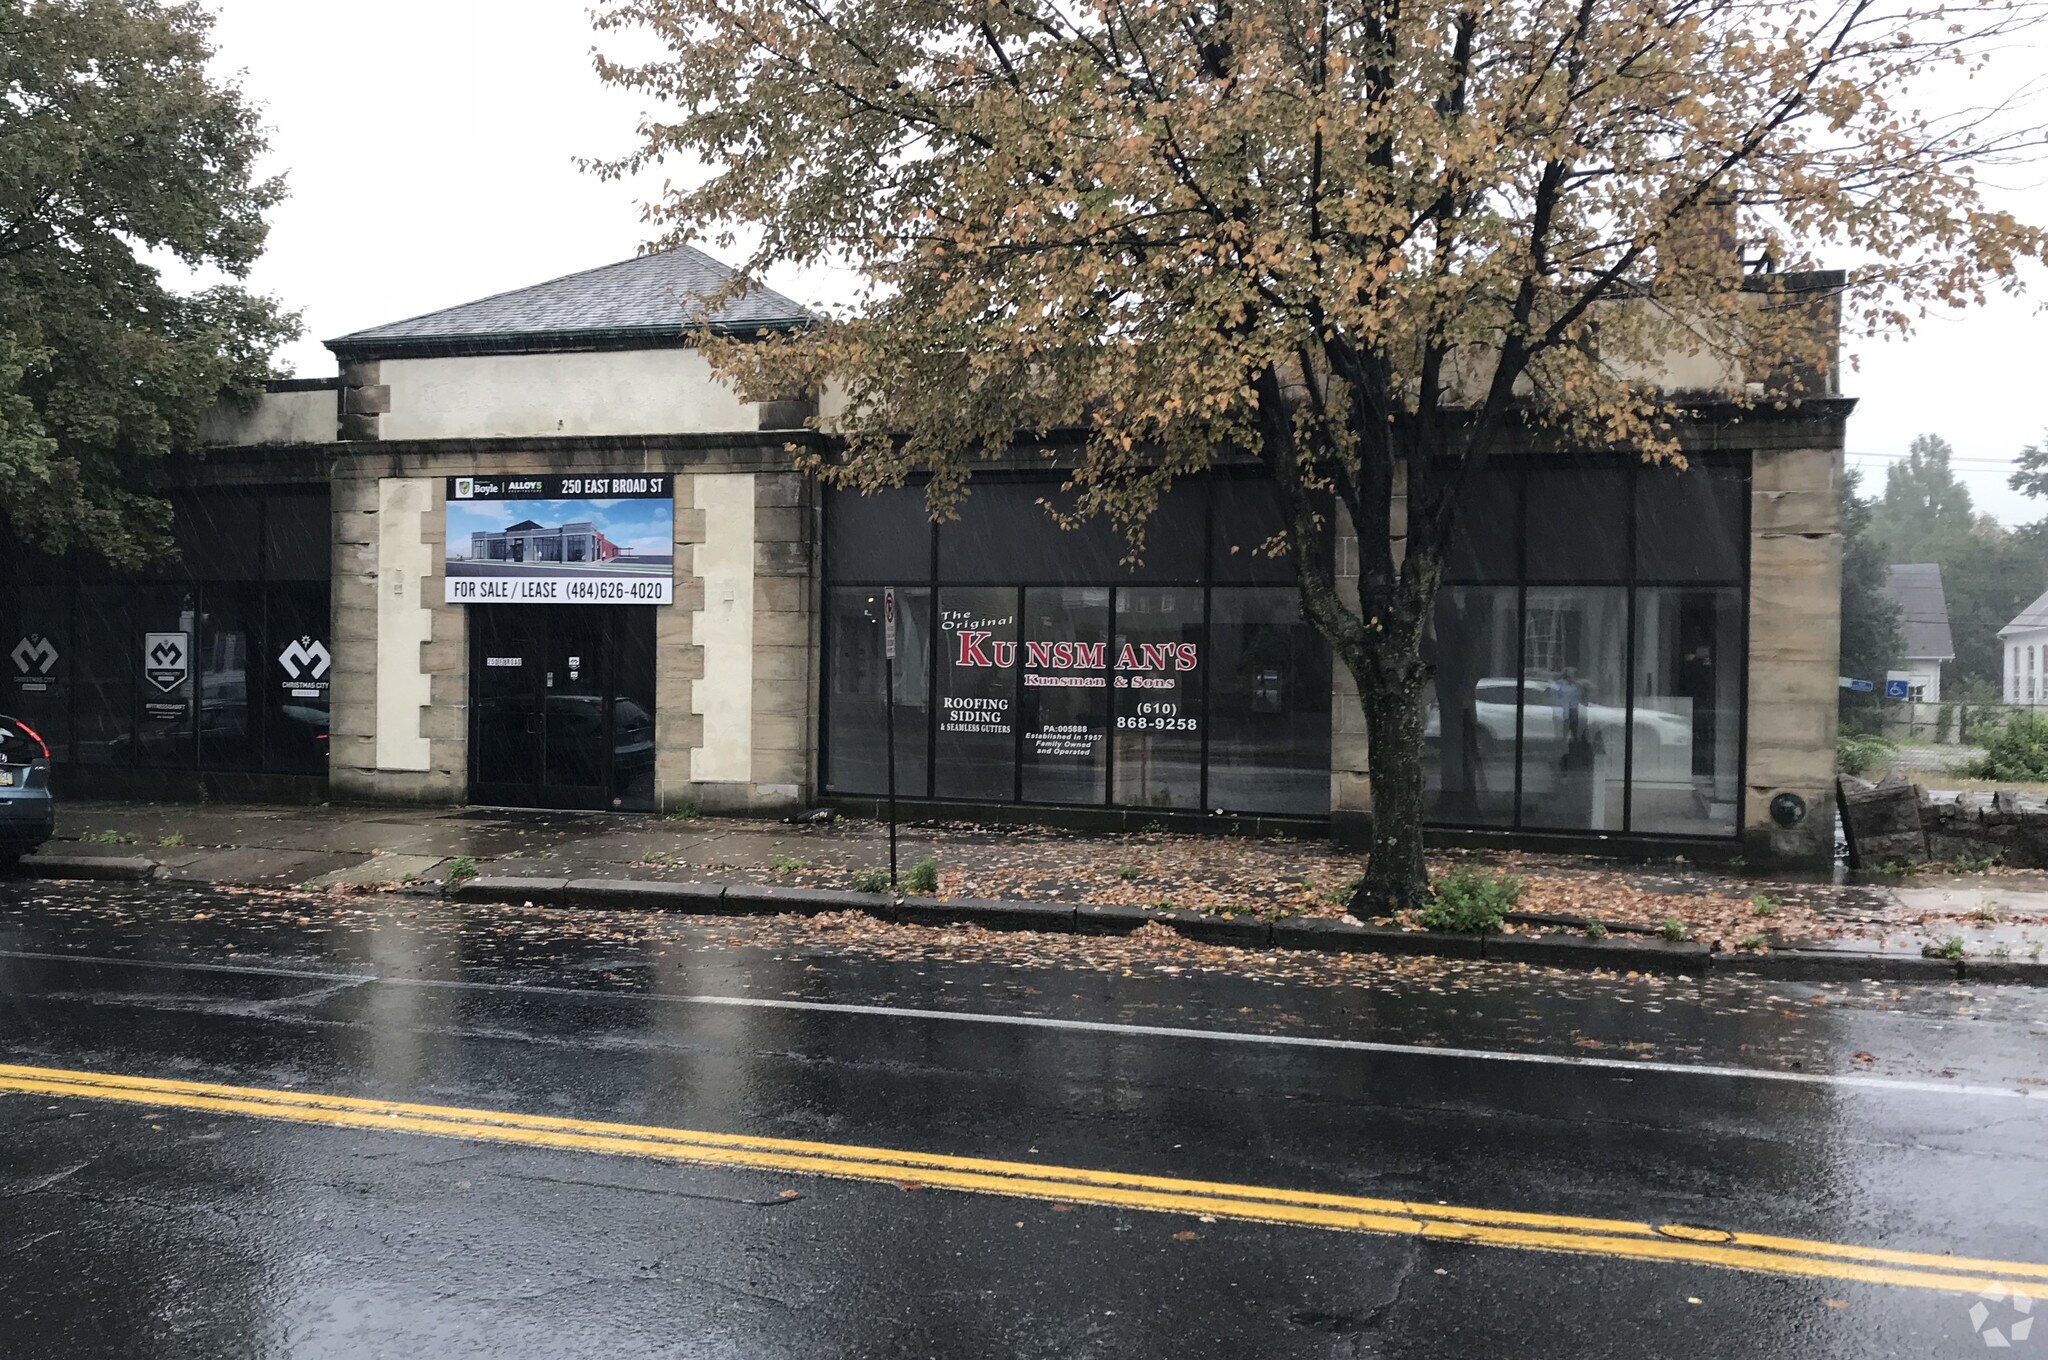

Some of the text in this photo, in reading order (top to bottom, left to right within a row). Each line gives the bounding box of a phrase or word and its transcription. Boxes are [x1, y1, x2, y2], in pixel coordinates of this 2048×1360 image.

[474, 484, 498, 496] Boyle
[508, 482, 542, 490] ALLOY5
[562, 479, 663, 494] 250 EAST BROAD ST
[454, 581, 663, 600] FOR SALE / LEASE (484)626-4020
[941, 610, 971, 621] The
[941, 615, 1014, 630] Original
[1024, 674, 1106, 687] Kunsman
[1114, 676, 1175, 688] & Sons
[943, 697, 1008, 710] ROOFING
[1137, 703, 1177, 716] (610)
[950, 710, 1001, 723] SIDING
[940, 723, 1011, 734] & SEAMLESS GUTTERS
[1116, 716, 1197, 731] 868-9258
[1025, 732, 1070, 741] Established
[1084, 734, 1103, 742] 1957
[1035, 740, 1091, 749] Family Owned
[1054, 748, 1090, 756] Operated
